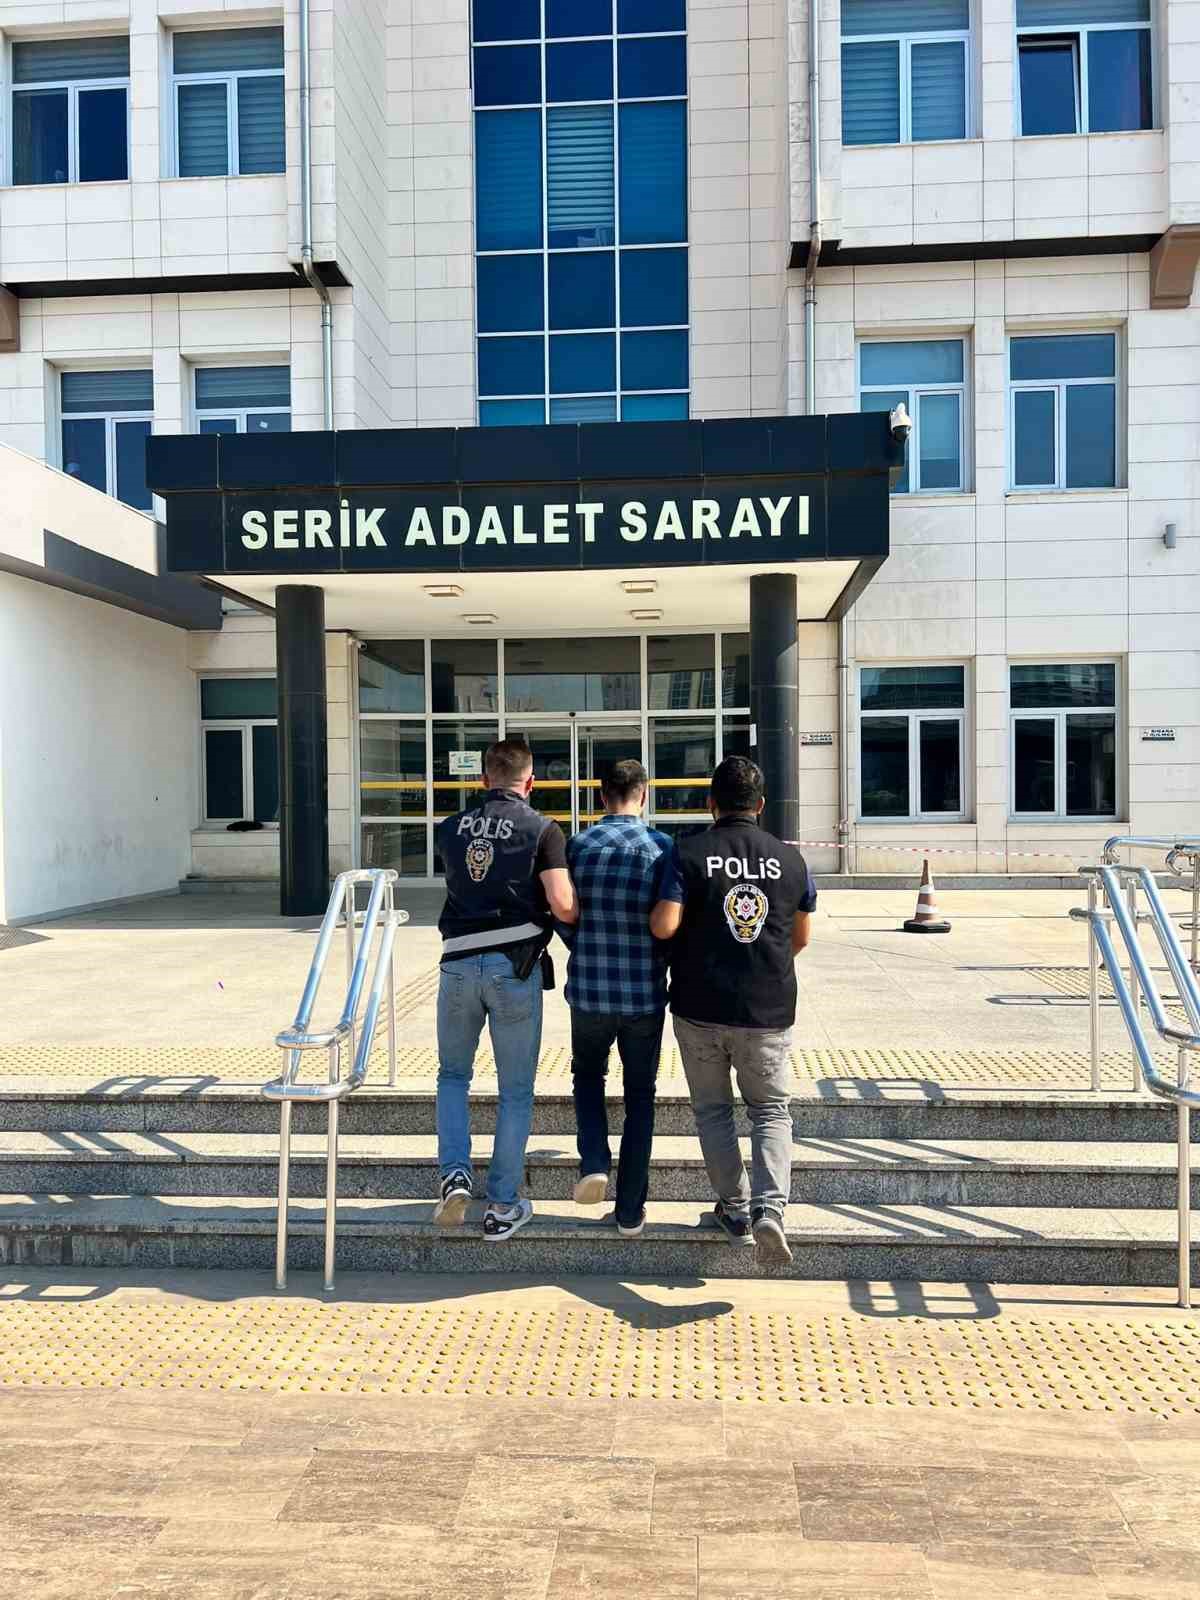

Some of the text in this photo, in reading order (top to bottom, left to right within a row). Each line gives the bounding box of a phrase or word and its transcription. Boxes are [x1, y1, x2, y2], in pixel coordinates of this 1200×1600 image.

[241, 495, 811, 550] SERİK ADALET SARAYI
